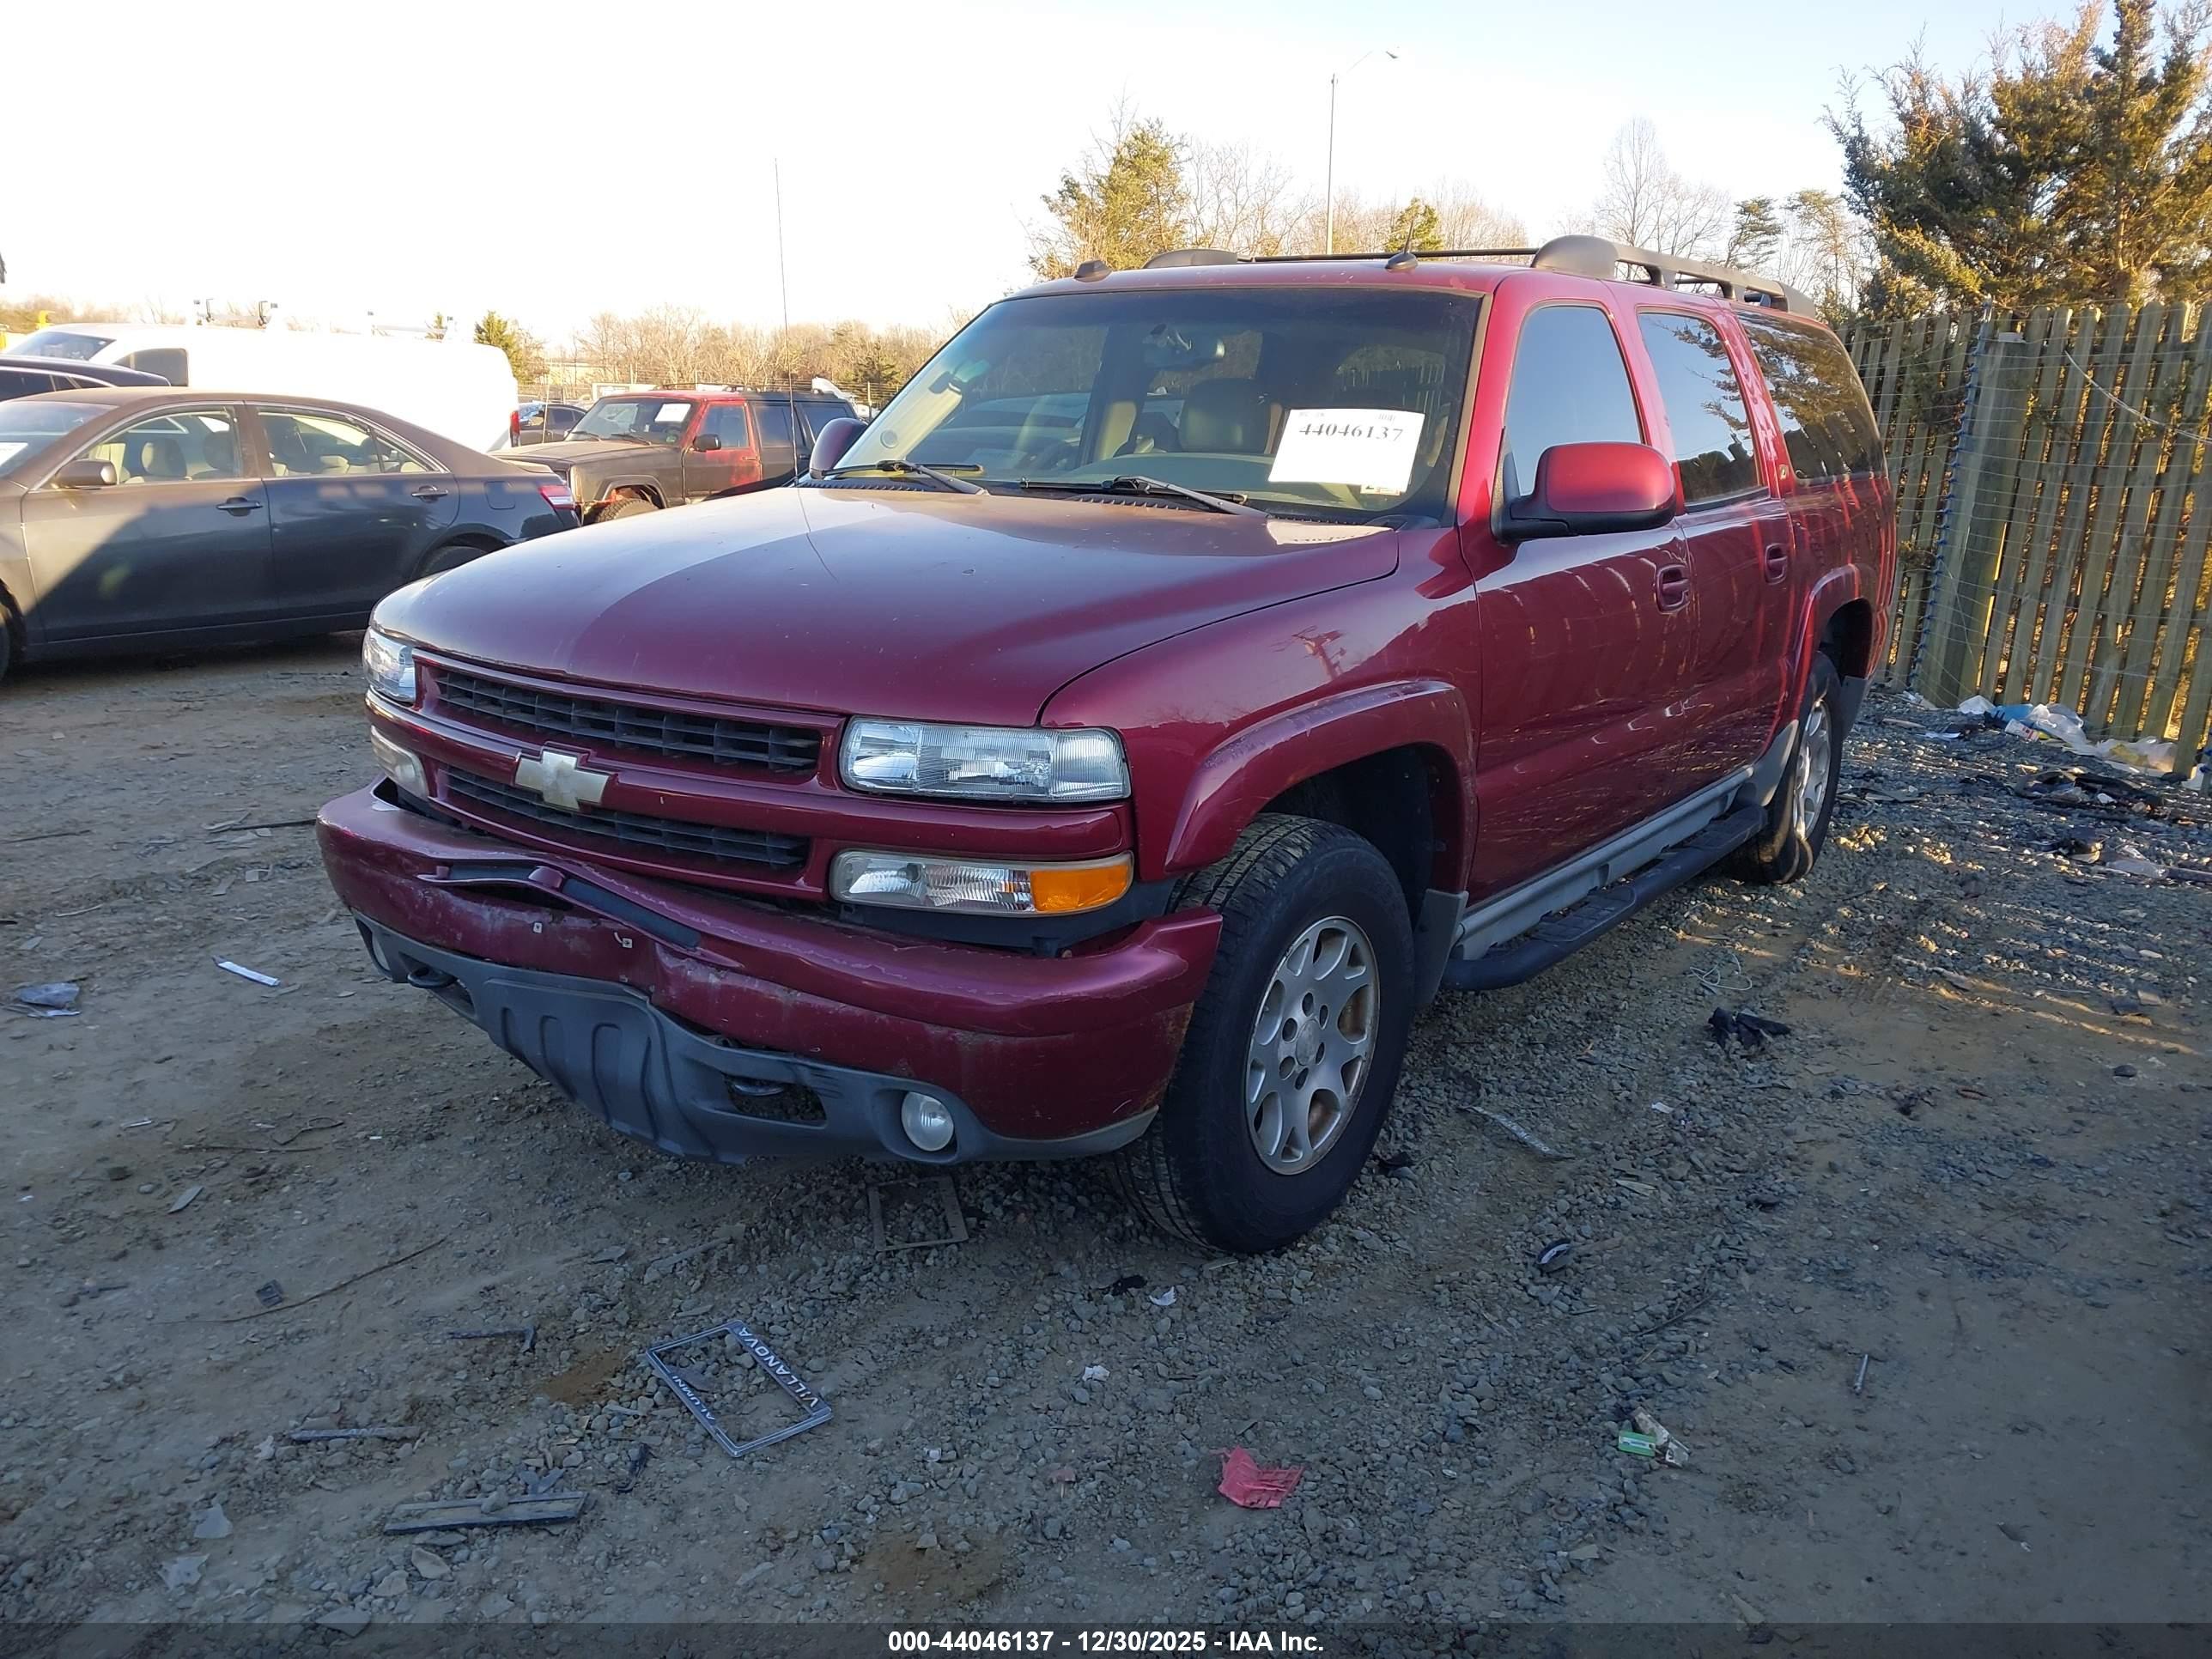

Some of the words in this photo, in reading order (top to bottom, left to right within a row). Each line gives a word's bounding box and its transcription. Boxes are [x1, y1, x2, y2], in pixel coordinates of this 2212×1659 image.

[1298, 422, 1404, 441] 44046137
[738, 1327, 818, 1407] VILLANOVA
[672, 1376, 715, 1420] ALUMNI
